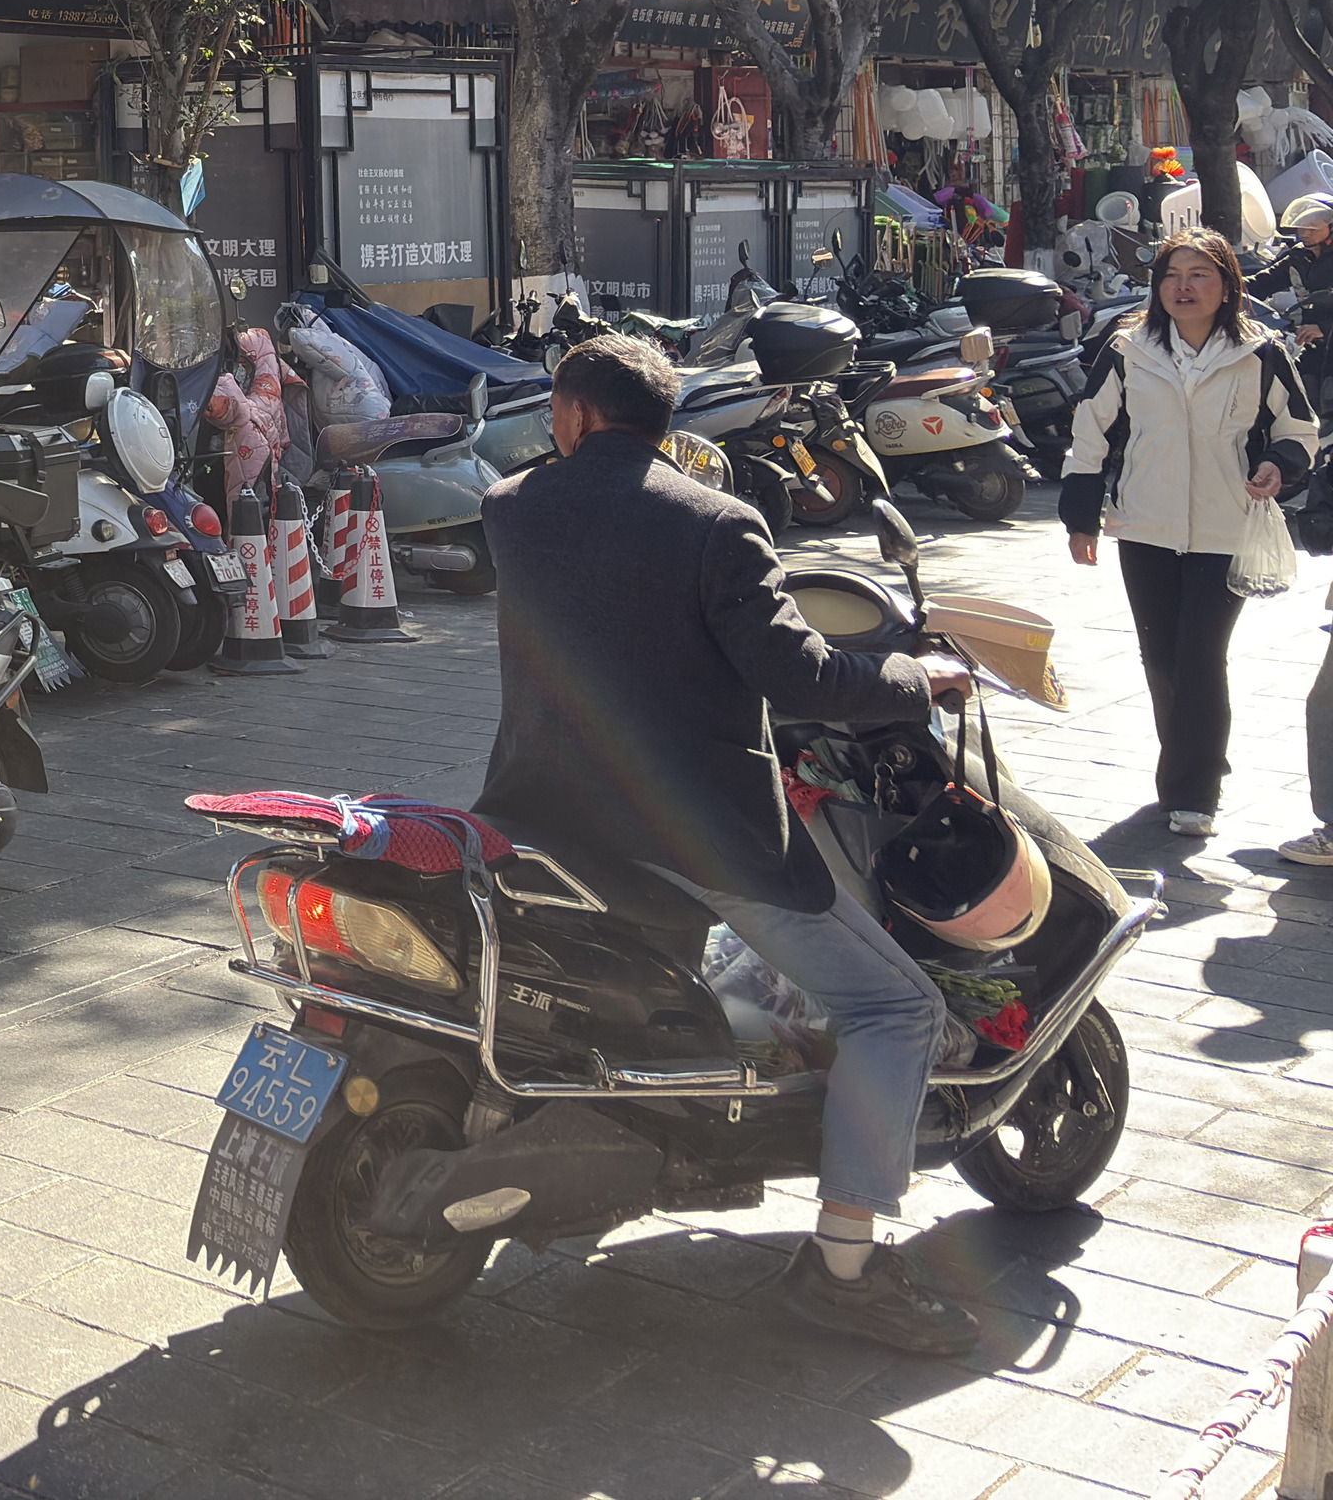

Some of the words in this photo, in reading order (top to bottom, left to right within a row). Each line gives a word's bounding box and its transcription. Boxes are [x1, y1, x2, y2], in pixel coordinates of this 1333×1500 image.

[205, 238, 277, 258] 文明大理
[360, 240, 474, 269] 携手打造文明大理
[874, 417, 907, 436] Retro
[367, 535, 386, 601] 禁止停车
[508, 982, 554, 1013] 王派
[223, 1066, 318, 1134] 94559
